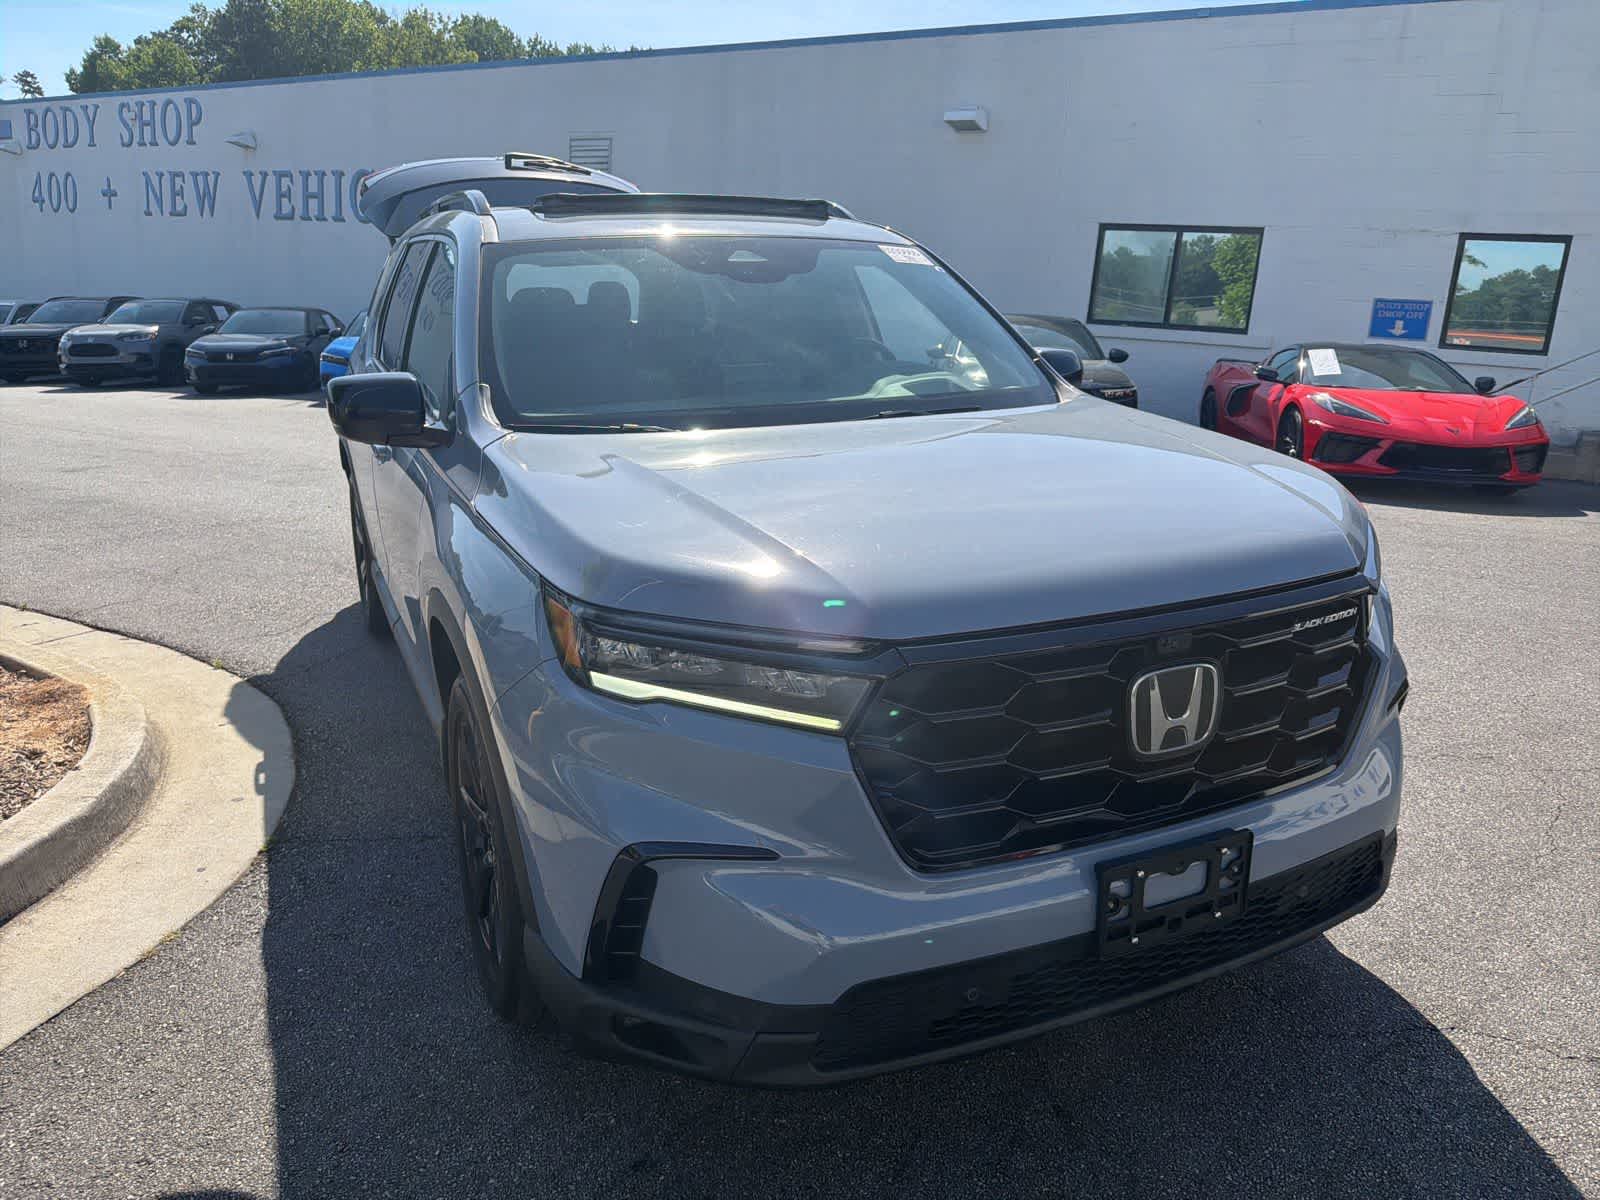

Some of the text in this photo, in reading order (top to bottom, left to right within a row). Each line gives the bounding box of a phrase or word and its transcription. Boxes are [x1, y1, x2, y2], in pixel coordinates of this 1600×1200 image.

[24, 97, 203, 149] BODY SHOP
[31, 171, 79, 214] 400
[142, 169, 221, 218] NEW
[1406, 311, 1425, 319] OFF
[1324, 607, 1358, 624] EDITION
